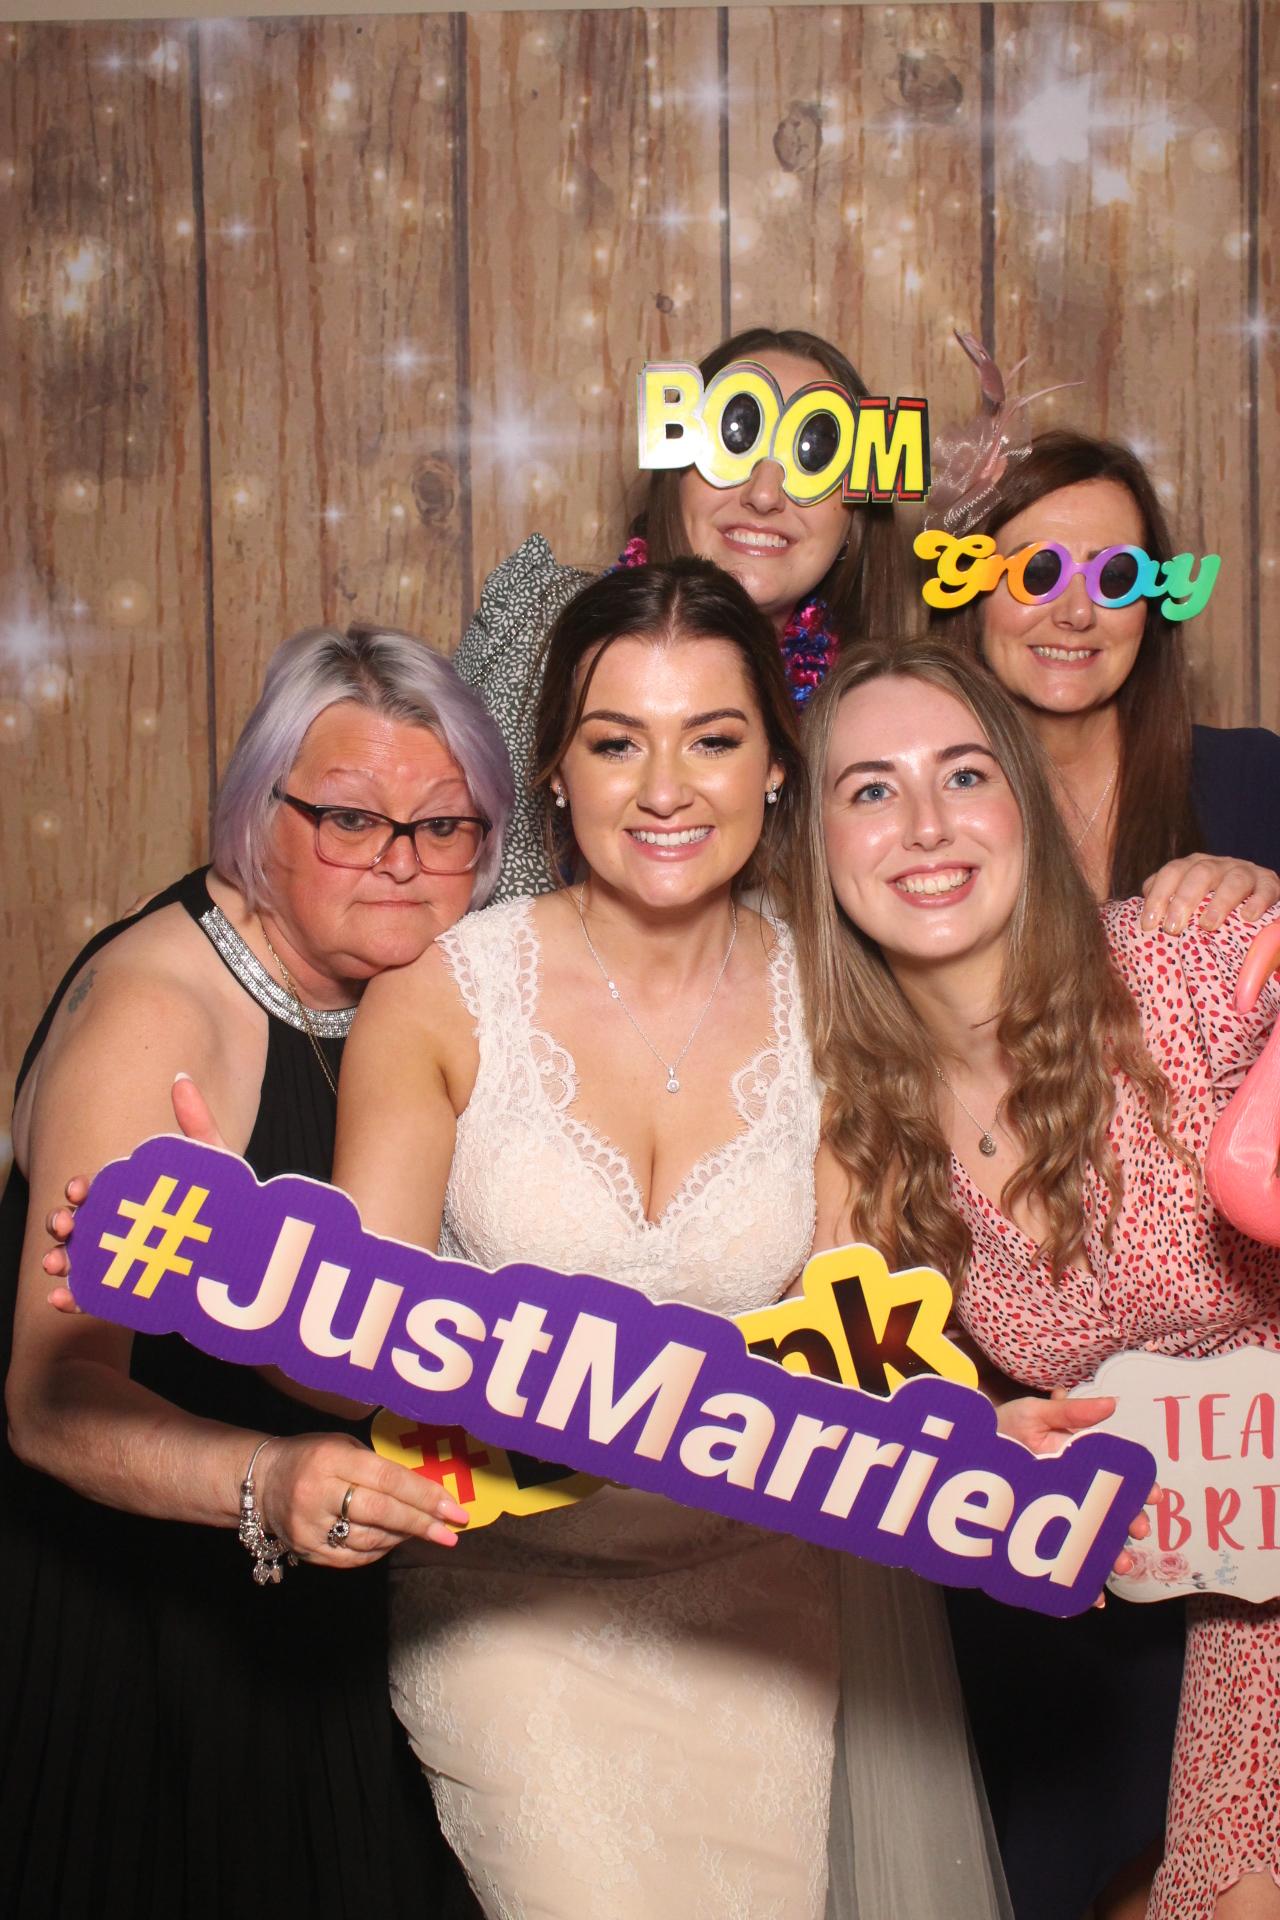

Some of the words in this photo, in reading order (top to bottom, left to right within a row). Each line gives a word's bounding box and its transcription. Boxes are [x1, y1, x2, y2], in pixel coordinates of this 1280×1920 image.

[637, 360, 931, 506] BOOM
[98, 1174, 1125, 1589] #JustMarried
[1152, 1392, 1275, 1462] TEA
[1156, 1484, 1280, 1552] BRI
